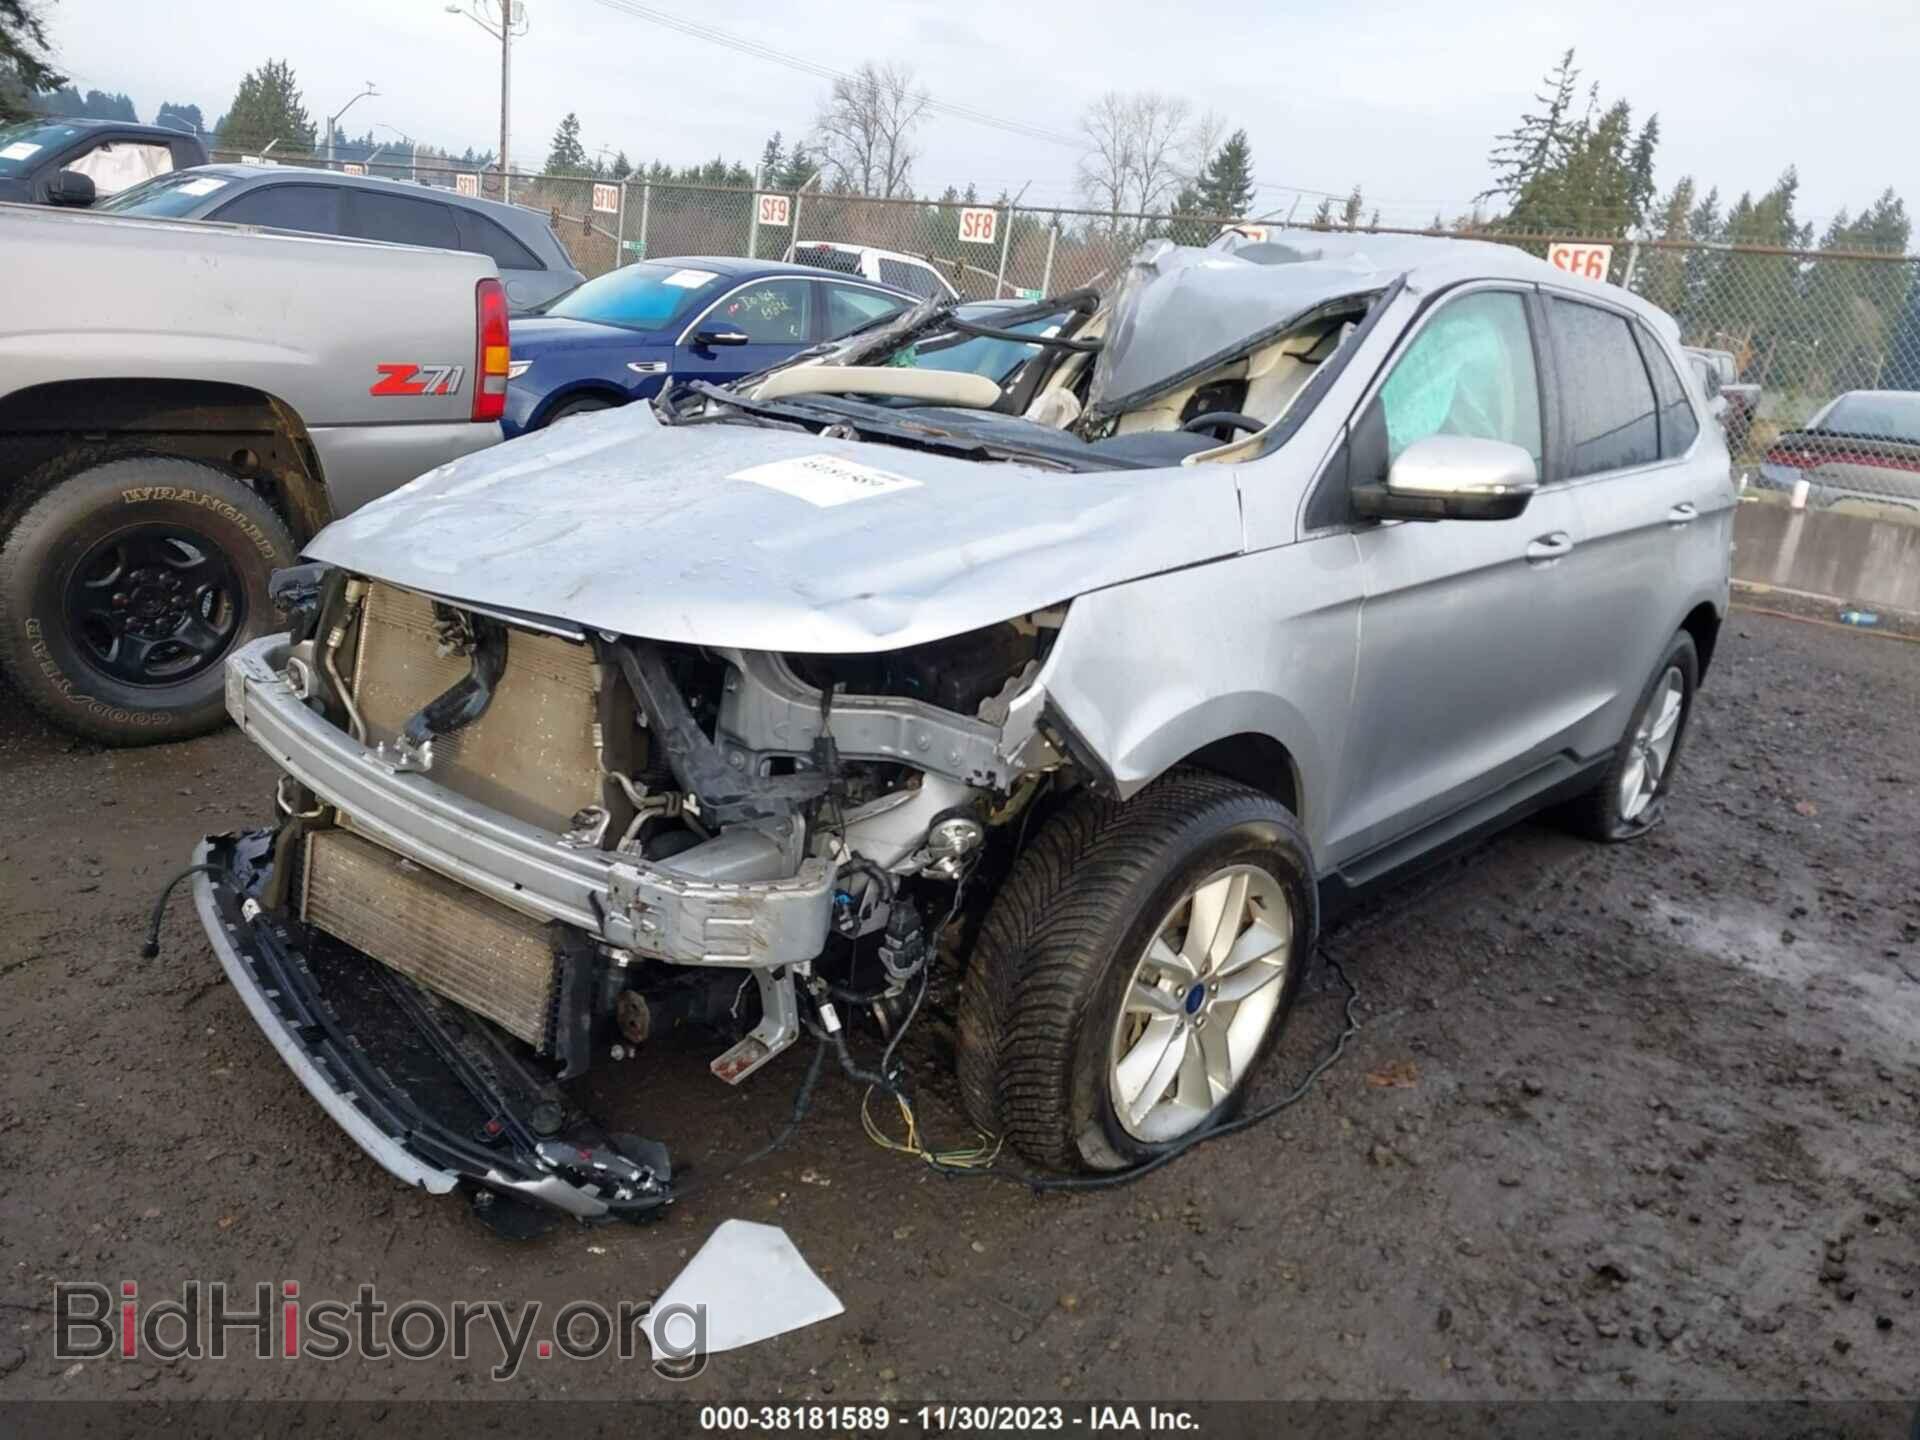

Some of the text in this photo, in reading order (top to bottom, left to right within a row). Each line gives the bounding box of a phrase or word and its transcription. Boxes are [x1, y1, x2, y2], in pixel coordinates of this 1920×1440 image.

[593, 186, 617, 210] SF10
[762, 198, 786, 222] SF9
[962, 212, 993, 239] SF8
[368, 363, 465, 396] Z71
[121, 486, 275, 560] WRANGLER
